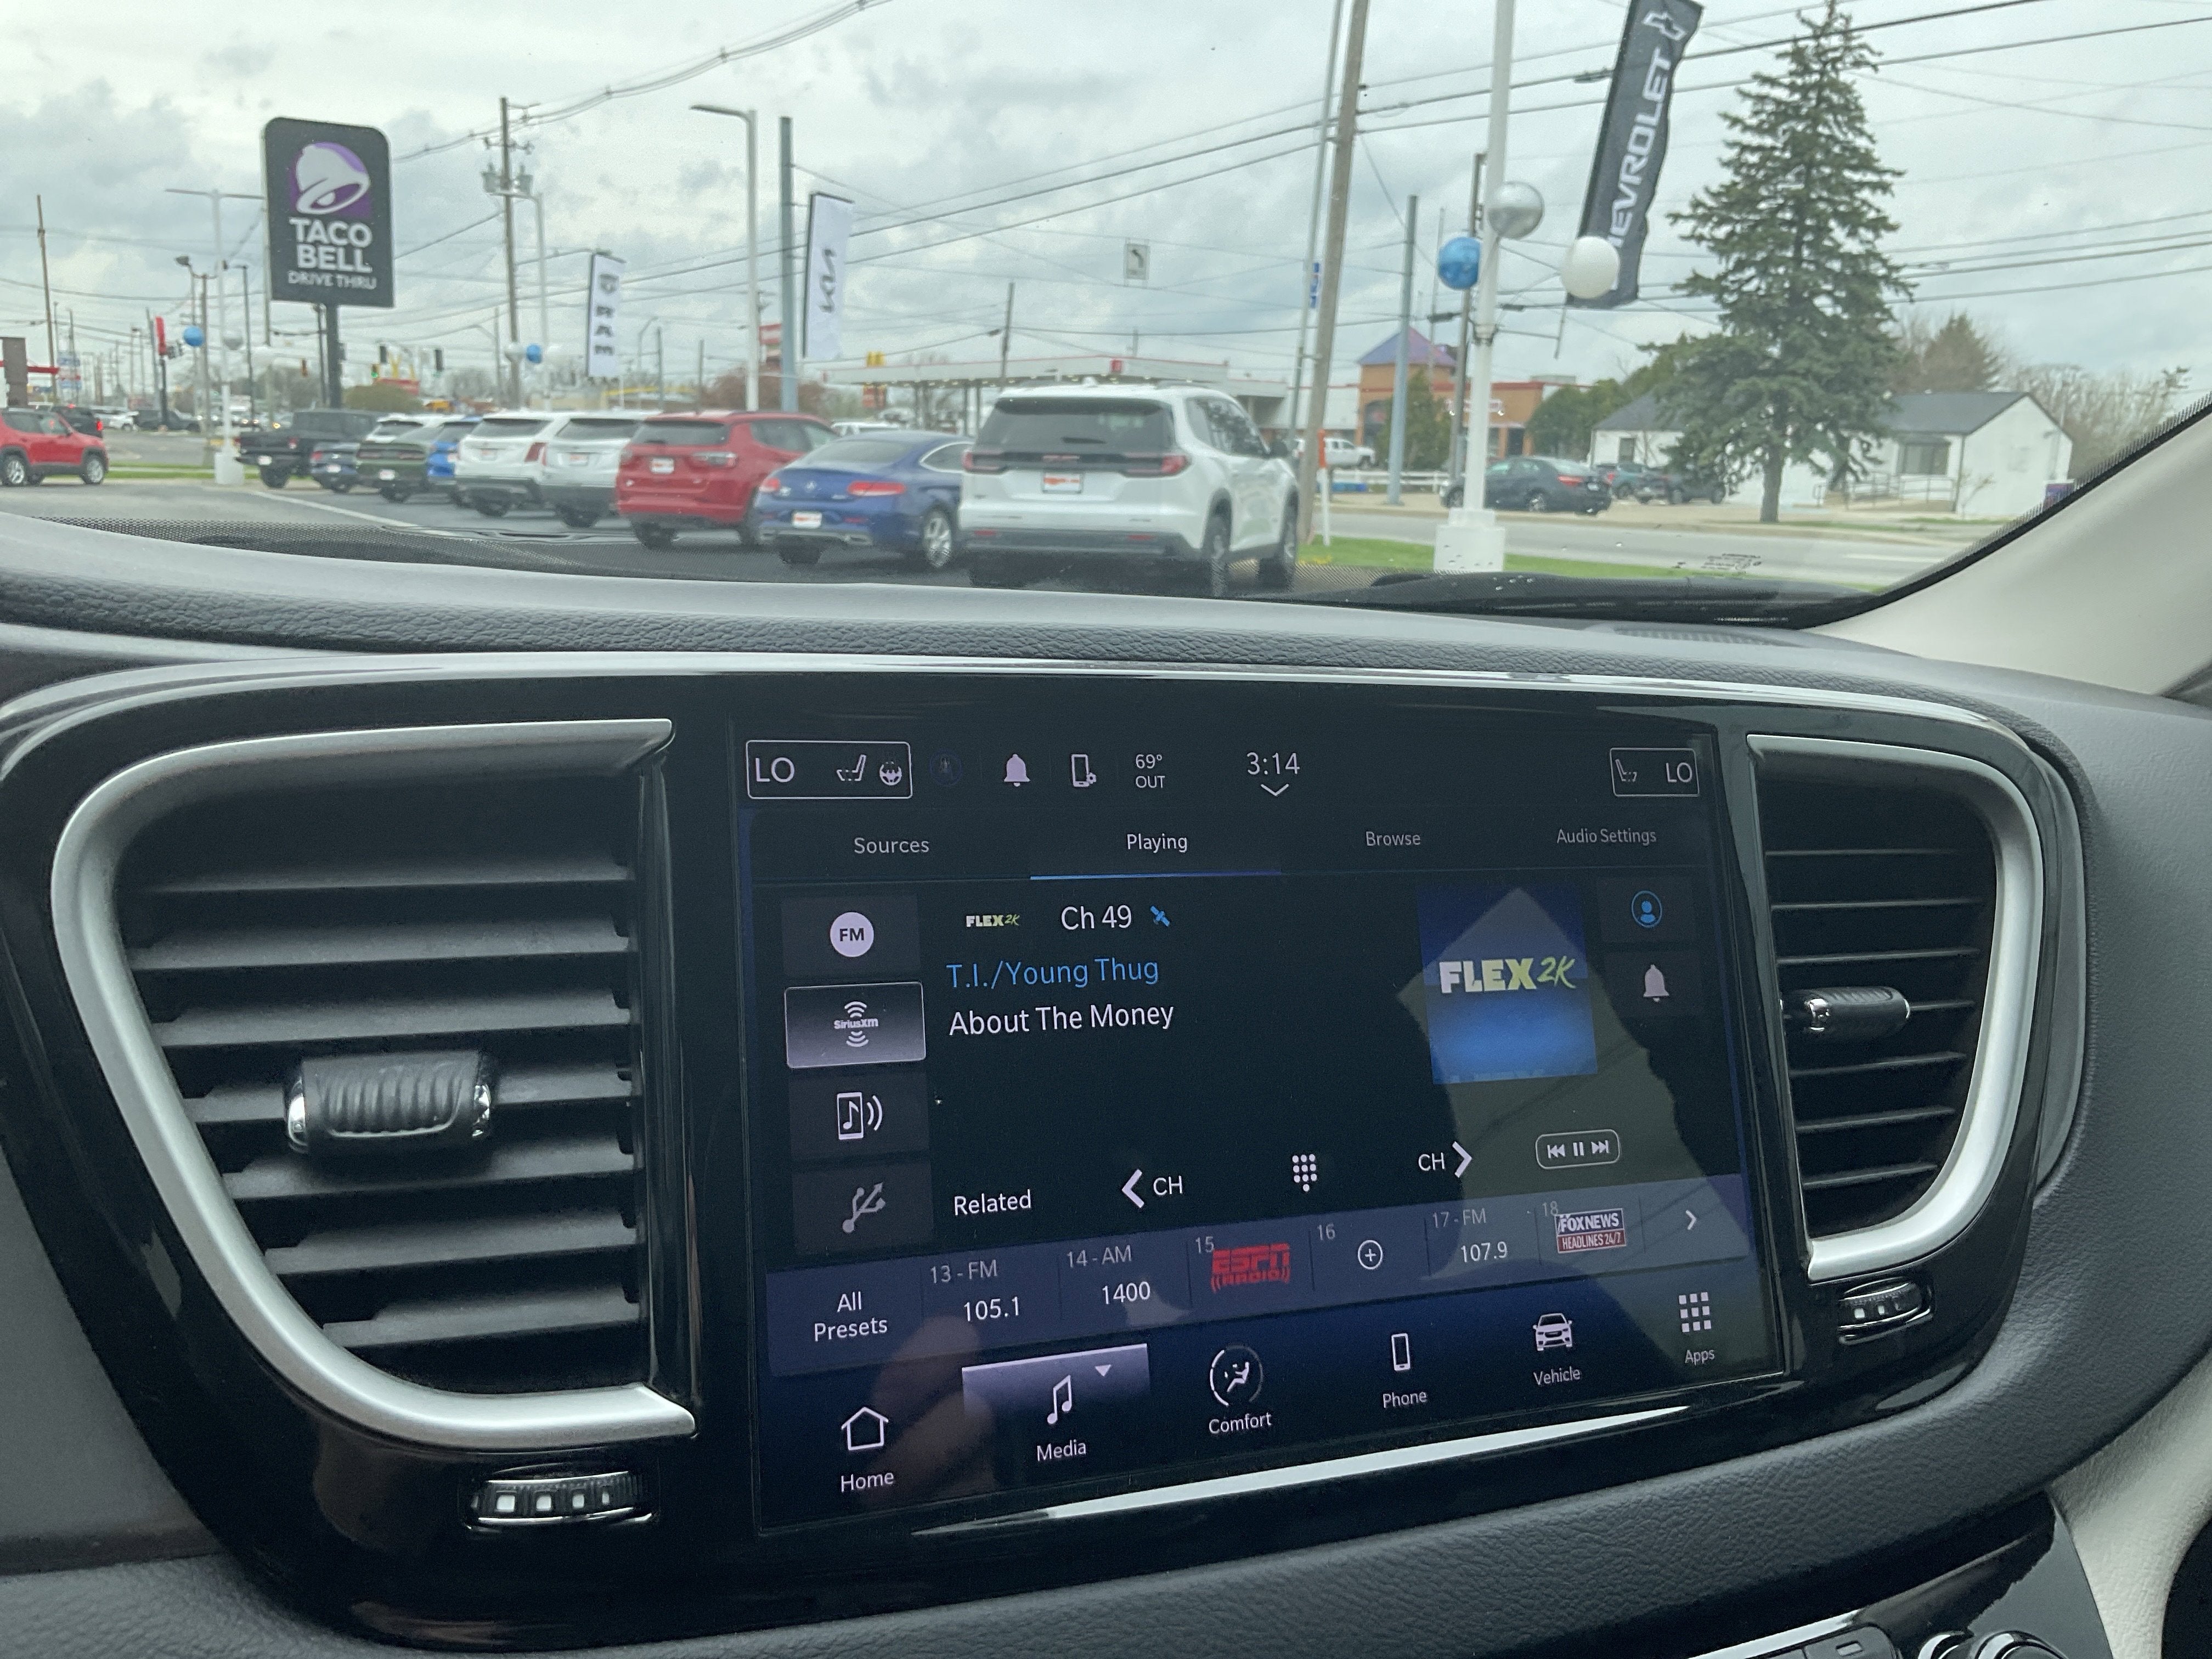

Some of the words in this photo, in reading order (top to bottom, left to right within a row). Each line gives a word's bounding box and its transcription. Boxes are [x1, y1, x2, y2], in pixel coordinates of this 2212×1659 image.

[1606, 47, 1671, 290] EVROLET
[289, 217, 373, 248] TACO
[297, 243, 373, 273] BELL
[287, 270, 333, 287] DRIVE
[336, 274, 377, 290] THRU
[755, 757, 795, 783] LO
[1135, 754, 1163, 769] 69°
[1246, 752, 1300, 775] 3:14
[1135, 775, 1165, 788] OUT
[1666, 762, 1693, 783] LO
[854, 837, 929, 854] Sources
[1127, 833, 1187, 854] Playing
[1365, 831, 1421, 847] Browse
[1556, 828, 1597, 844] Audio
[1600, 827, 1657, 846] Settings
[1061, 906, 1094, 930] Ch
[1102, 905, 1132, 928] 49
[839, 927, 865, 942] FM
[1094, 957, 1158, 985] Thug
[949, 1010, 1030, 1036] About
[1035, 1006, 1082, 1030] The
[1091, 1003, 1174, 1030] Money
[1418, 1152, 1445, 1171] CH
[1153, 1175, 1183, 1196] CH
[954, 1189, 1031, 1216] Related
[1543, 1201, 1559, 1217] 18
[1318, 1223, 1335, 1240] 16
[1562, 1234, 1604, 1250] HEADLINES
[1604, 1232, 1622, 1245] 24/7
[1195, 1236, 1215, 1254] 15
[1461, 1241, 1508, 1263] 107.9
[1212, 1242, 1290, 1274] ESPN
[837, 1291, 862, 1312] All
[1102, 1281, 1150, 1305] 1400
[964, 1296, 1019, 1322] 105.1
[814, 1317, 888, 1342] Presets
[1685, 1350, 1715, 1365] Apps
[1533, 1365, 1581, 1385] Vehicle
[1383, 1391, 1427, 1408] Phone
[1209, 1412, 1272, 1434] Comfort
[1037, 1439, 1086, 1462] Media
[841, 1472, 894, 1492] Home
